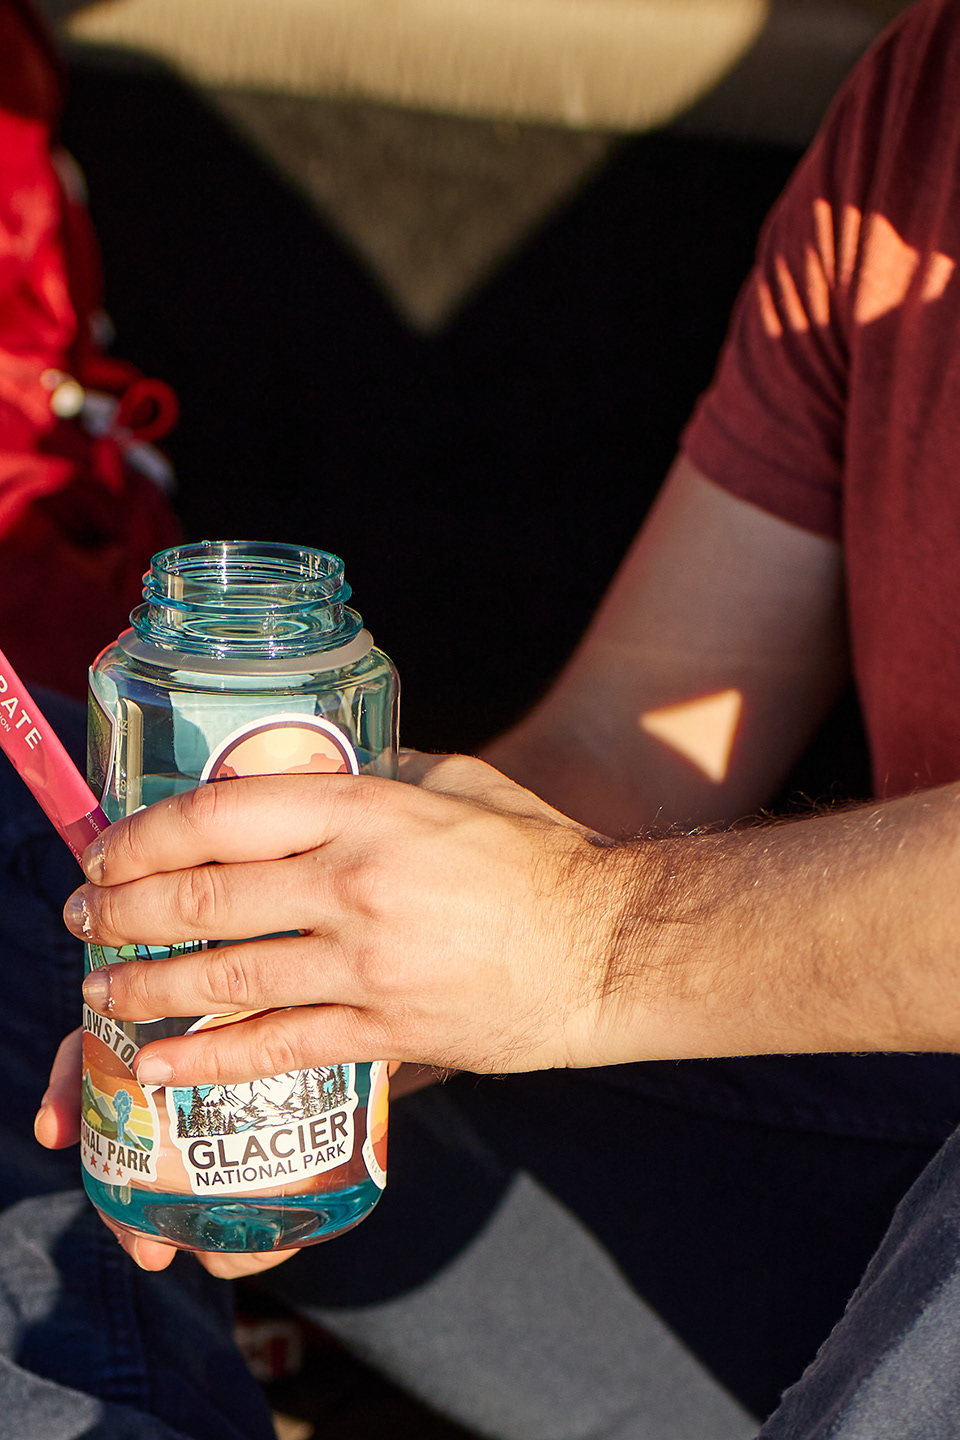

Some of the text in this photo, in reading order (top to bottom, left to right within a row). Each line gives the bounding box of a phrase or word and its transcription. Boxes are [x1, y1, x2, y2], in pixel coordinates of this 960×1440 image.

[107, 1141, 151, 1174] PARK
[188, 1111, 349, 1170] GLACIER
[196, 1140, 346, 1187] NATIONAL PARK
